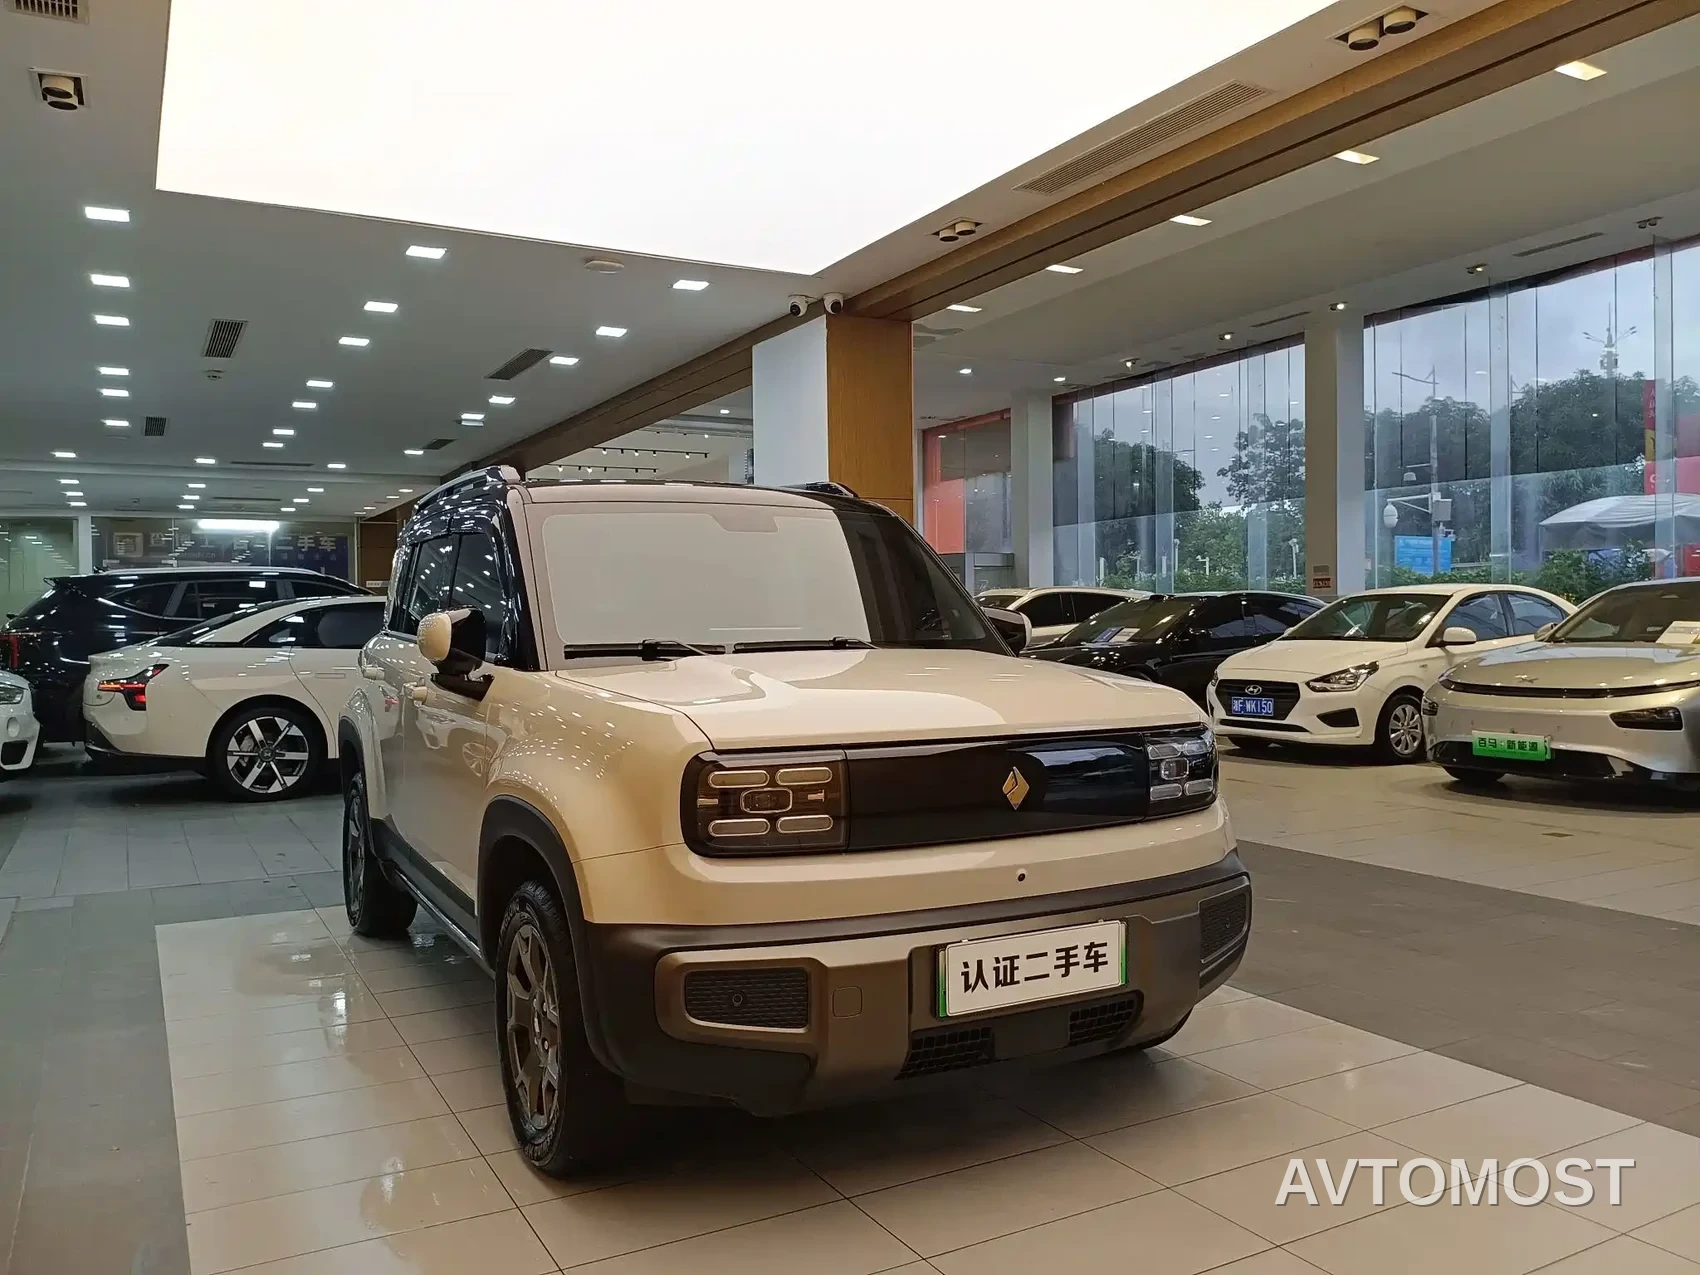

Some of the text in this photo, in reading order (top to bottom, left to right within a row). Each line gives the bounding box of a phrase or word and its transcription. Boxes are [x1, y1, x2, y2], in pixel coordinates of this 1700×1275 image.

[961, 942, 1108, 993] 认证二手车
